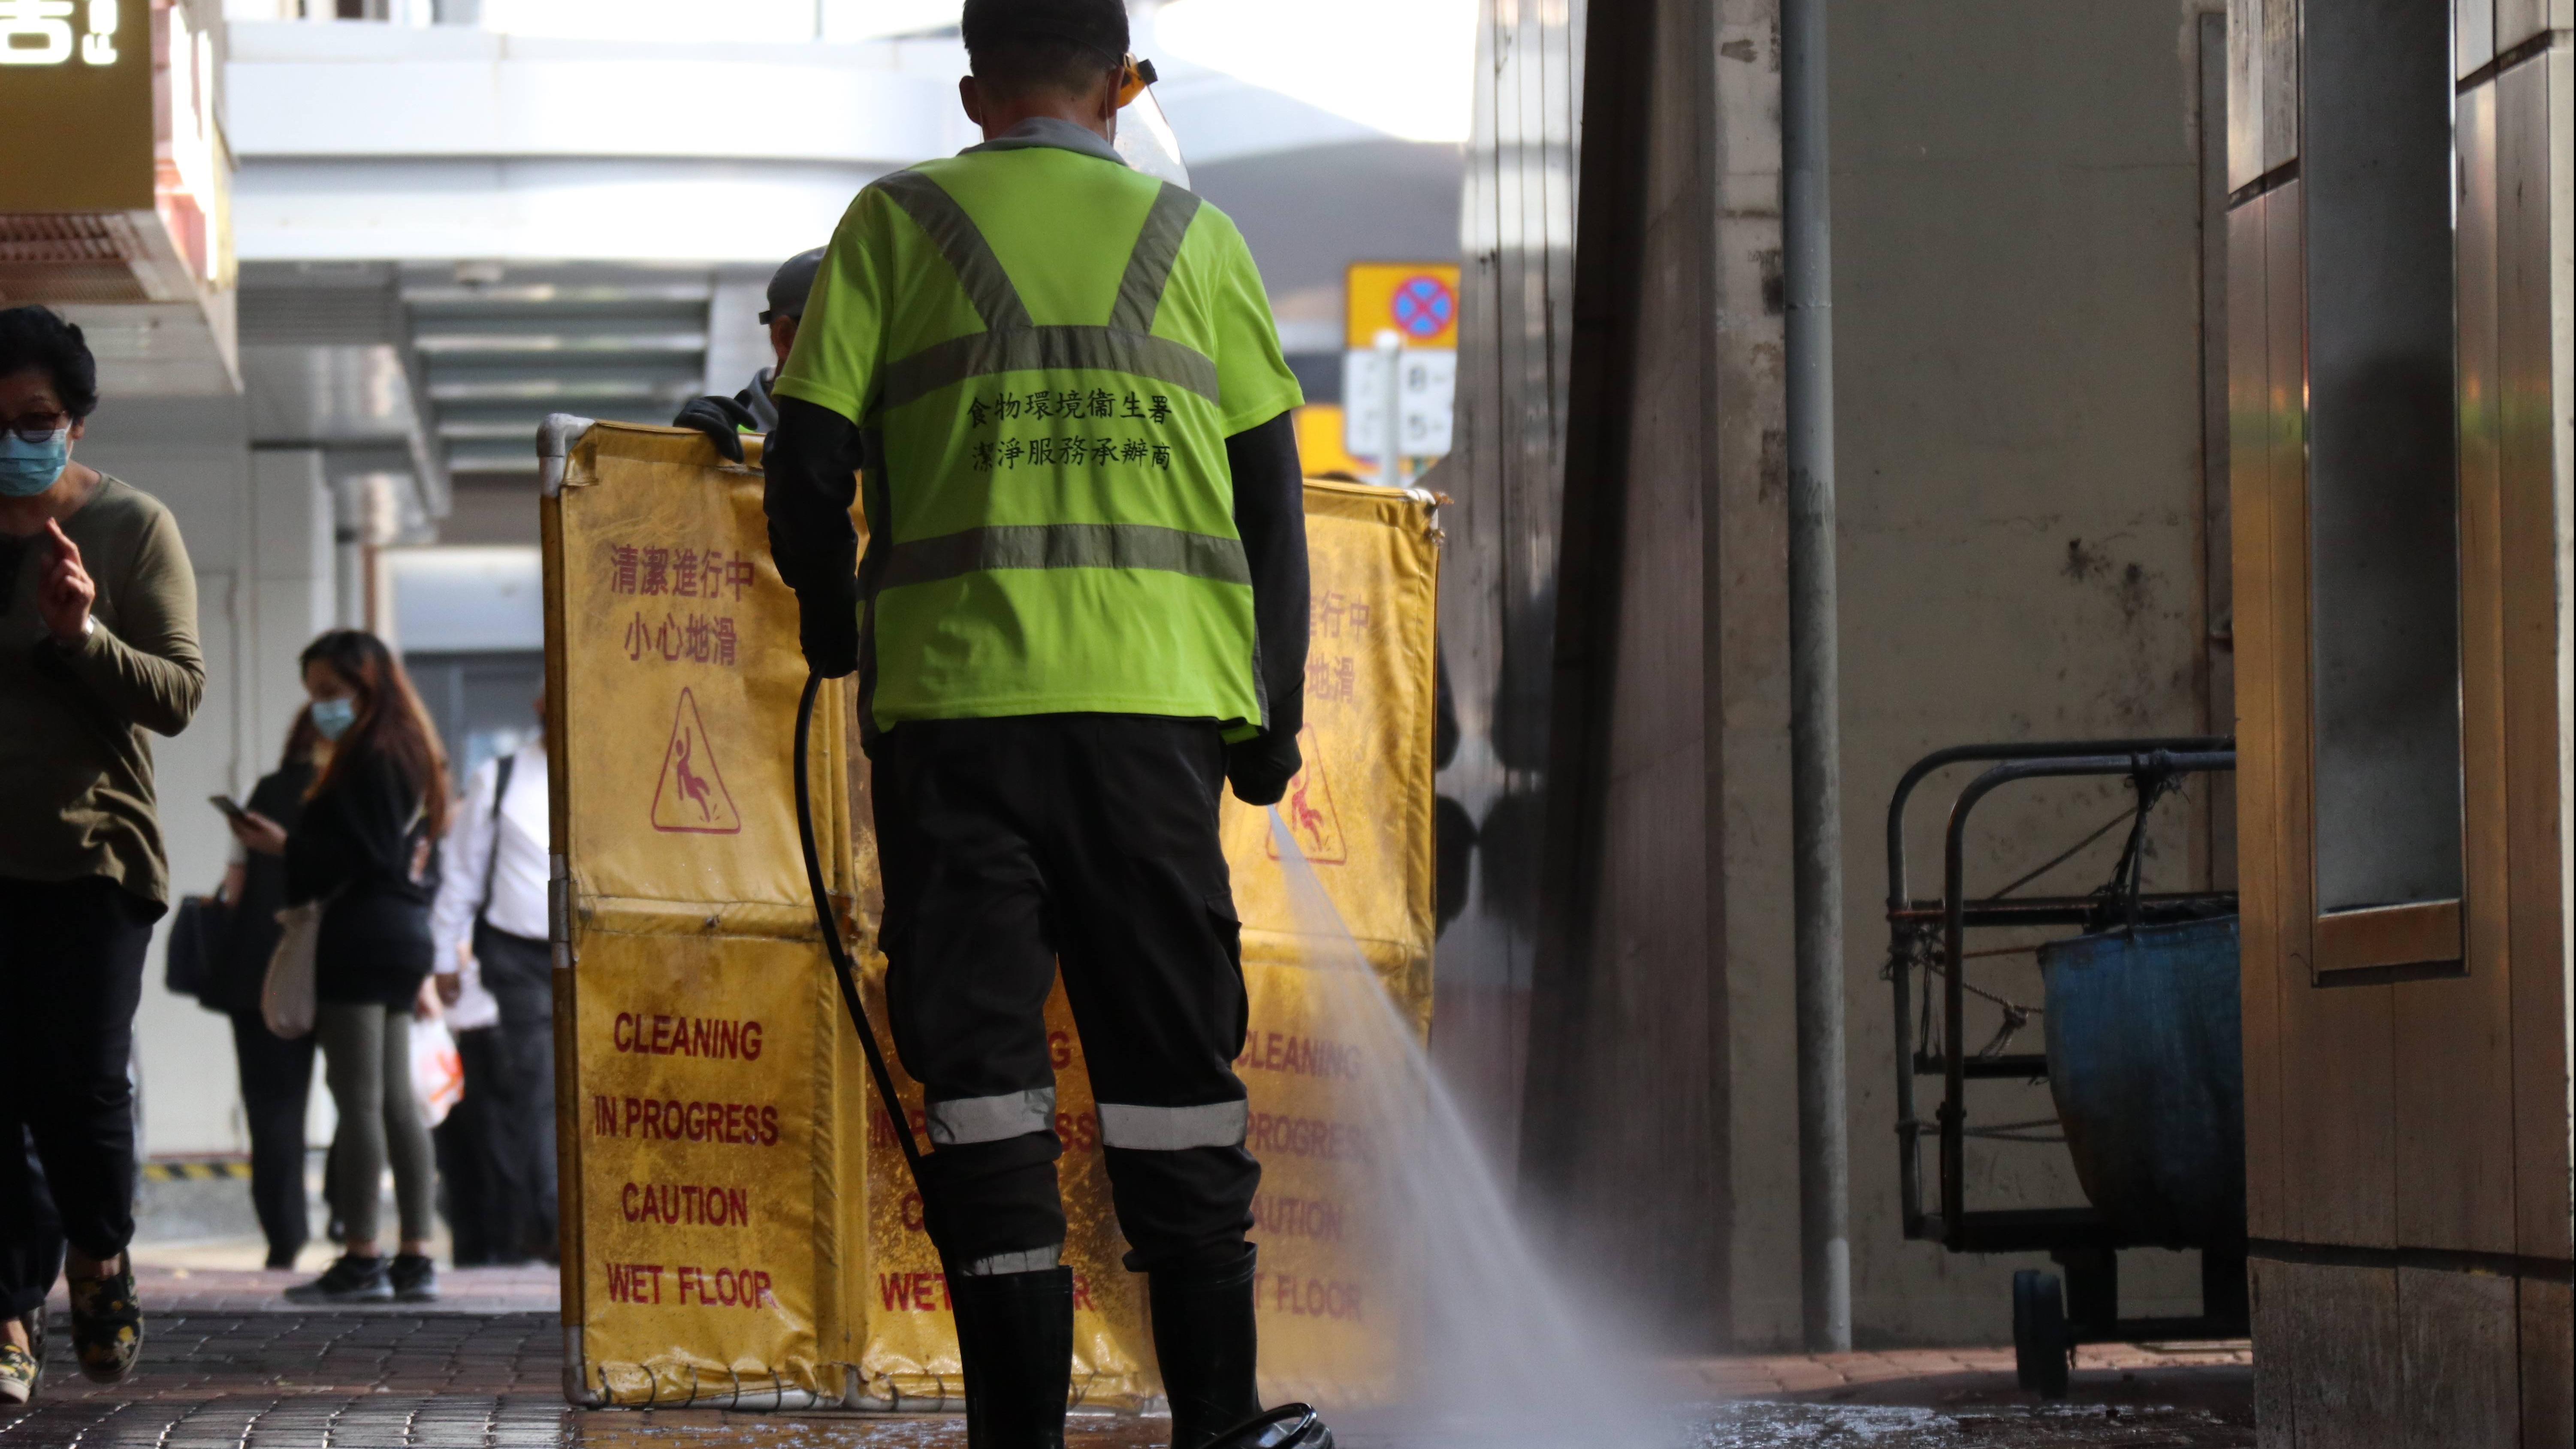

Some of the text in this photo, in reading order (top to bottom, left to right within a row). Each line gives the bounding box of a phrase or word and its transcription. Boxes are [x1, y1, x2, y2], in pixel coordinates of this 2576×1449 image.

[972, 435, 1171, 472] 潔淨服務承辦商
[611, 544, 754, 601] 清潔進行中
[624, 611, 737, 666] 小心地滑
[613, 1012, 763, 1061] CLEANING
[595, 1095, 779, 1147] IN PROGRESS
[622, 1182, 748, 1227] CAUTION
[606, 1263, 779, 1310] WET FLOOR
